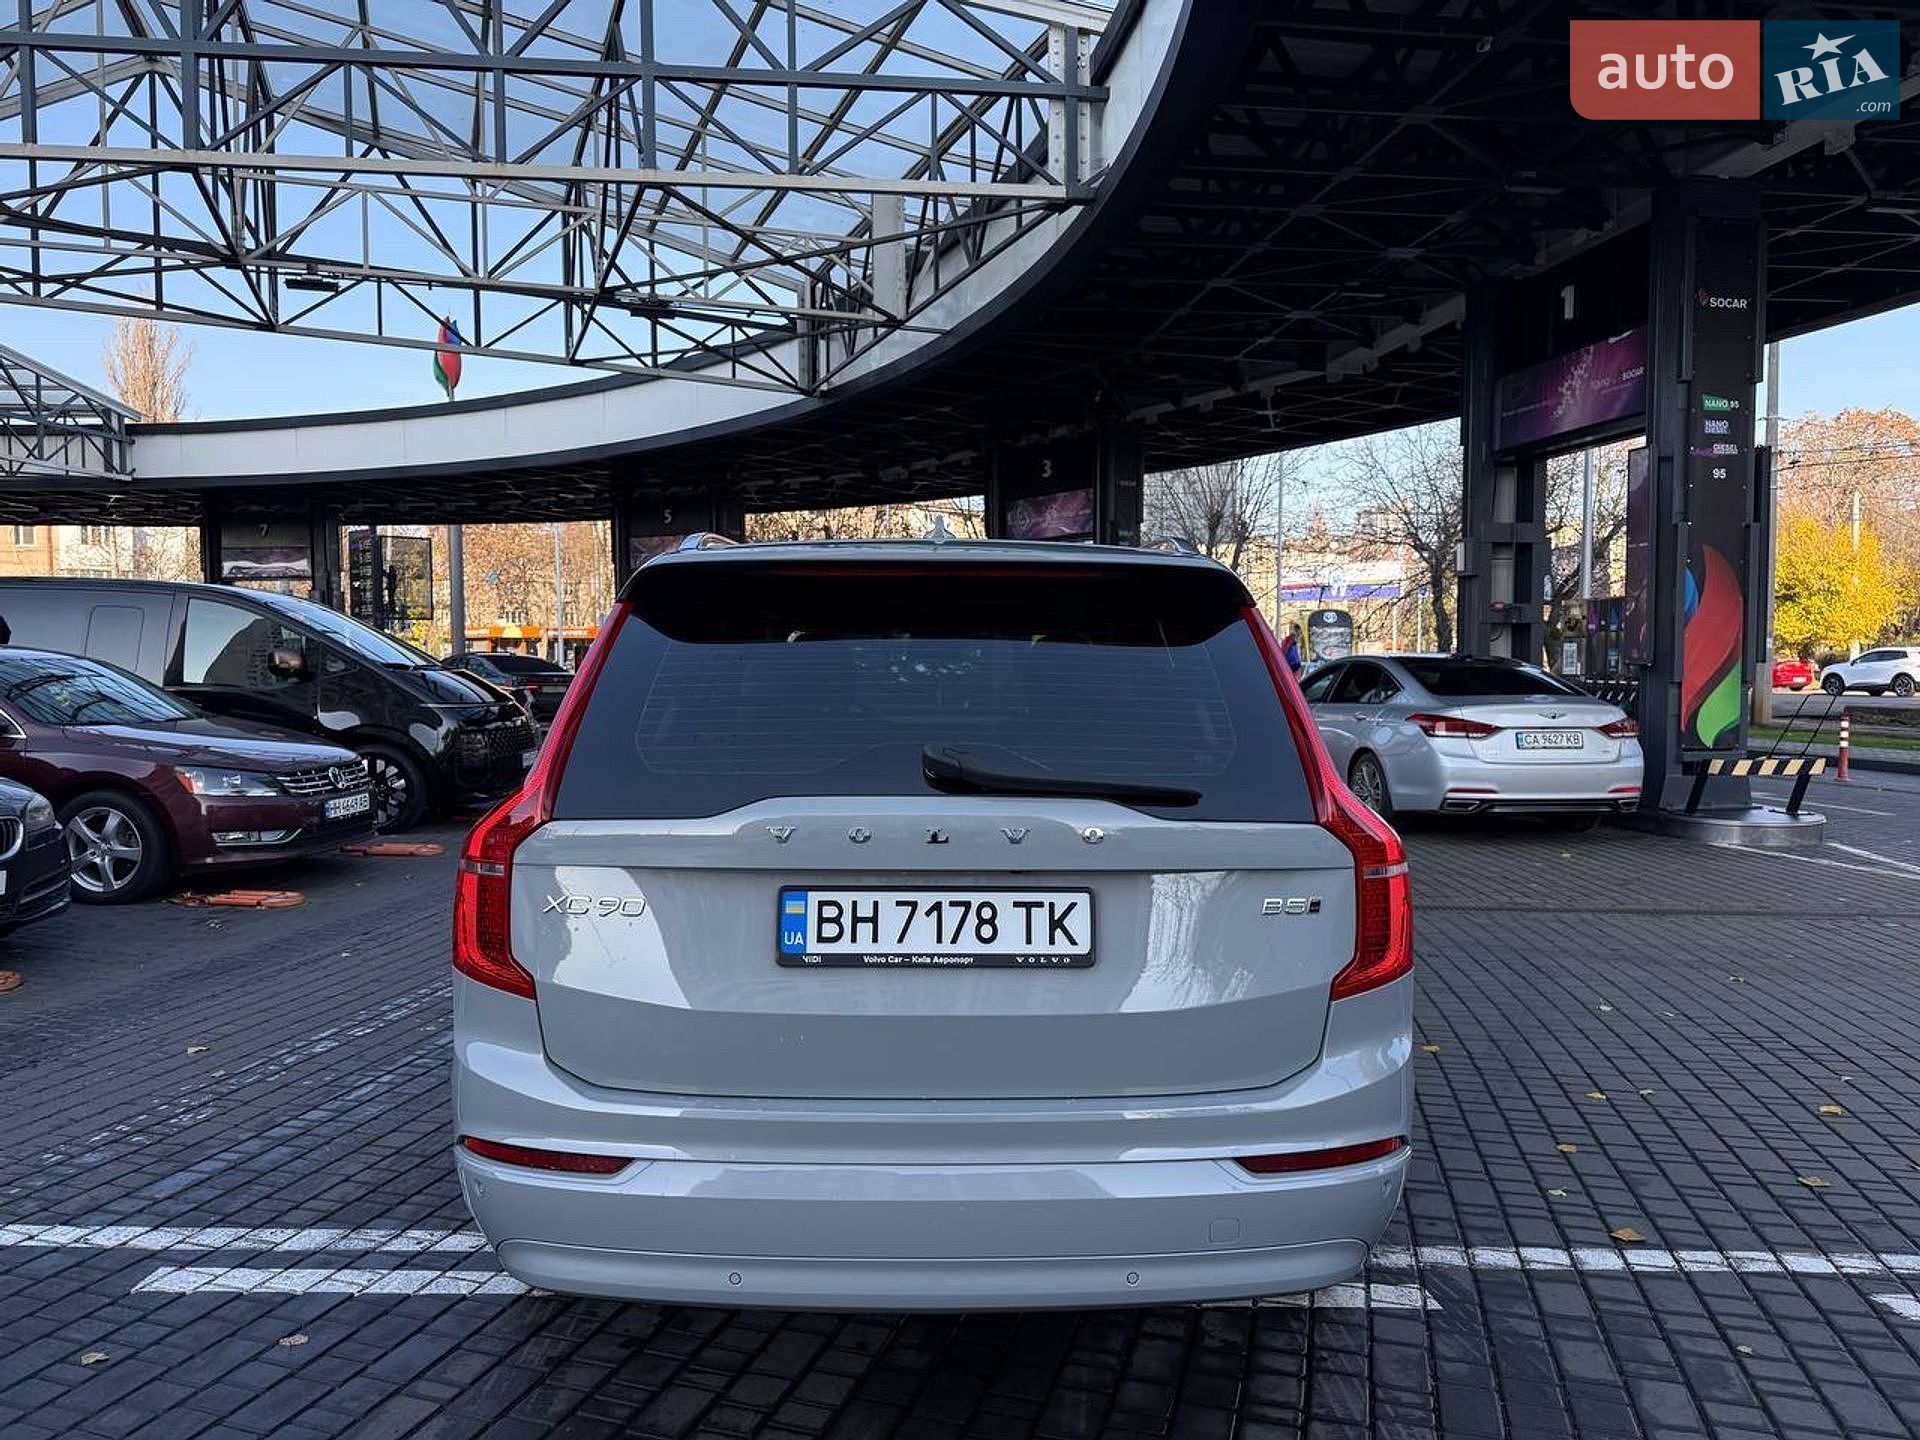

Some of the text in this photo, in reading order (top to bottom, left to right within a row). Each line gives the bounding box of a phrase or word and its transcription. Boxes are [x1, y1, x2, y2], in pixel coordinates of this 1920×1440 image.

[1560, 286, 1574, 320] 1
[1709, 296, 1748, 309] SOCAR
[1704, 398, 1728, 409] NANO
[1704, 419, 1729, 428] NANO
[1041, 459, 1053, 477] 3
[1712, 467, 1727, 479] 95
[663, 508, 672, 525] 5
[258, 523, 268, 537] 7
[1524, 733, 1540, 745] CA
[765, 825, 1105, 845] VOLVO
[1262, 898, 1306, 915] B5
[816, 899, 1079, 946] BH 7178 TK
[783, 931, 804, 945] UA
